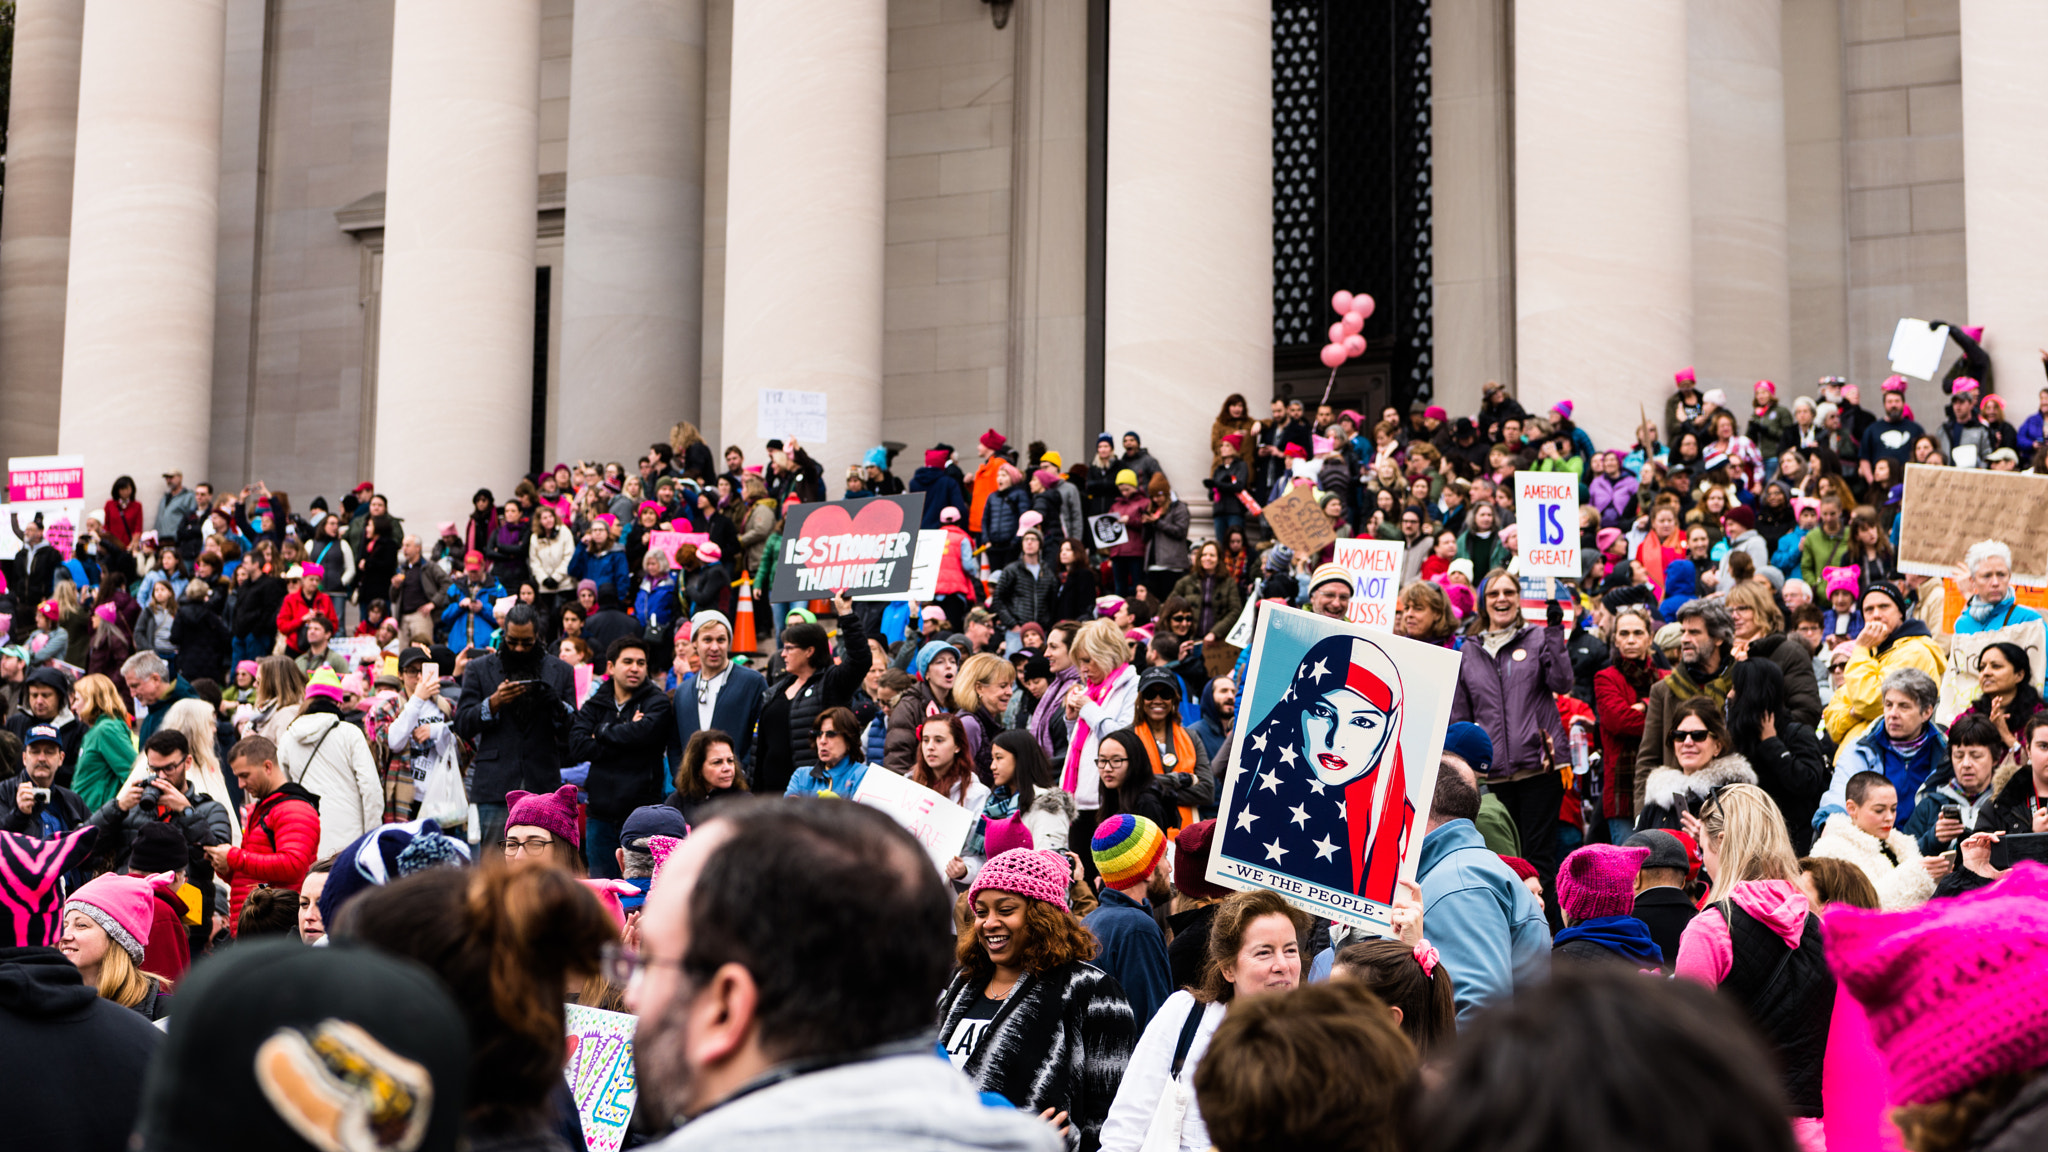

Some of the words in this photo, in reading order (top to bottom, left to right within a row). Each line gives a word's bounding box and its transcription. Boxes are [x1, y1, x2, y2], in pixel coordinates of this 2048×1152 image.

[13, 472, 36, 487] BUILD
[38, 470, 81, 485] COMMUNITY
[26, 486, 41, 500] NOT
[42, 484, 68, 499] WALLS
[1523, 485, 1572, 499] AMERICA
[1539, 504, 1564, 545] IS
[784, 537, 814, 564] IS
[811, 531, 911, 564] STRONGER
[1529, 549, 1573, 567] GREAT!
[1339, 548, 1397, 572] WOMEN
[796, 564, 844, 591] THAN
[842, 561, 896, 588] HATE!
[1356, 576, 1390, 599] NOT
[1236, 864, 1264, 882] WE
[1269, 874, 1303, 894] THE
[1307, 886, 1375, 916] PEOPLE
[1309, 905, 1335, 917] THAN
[1338, 914, 1363, 926] FEAR
